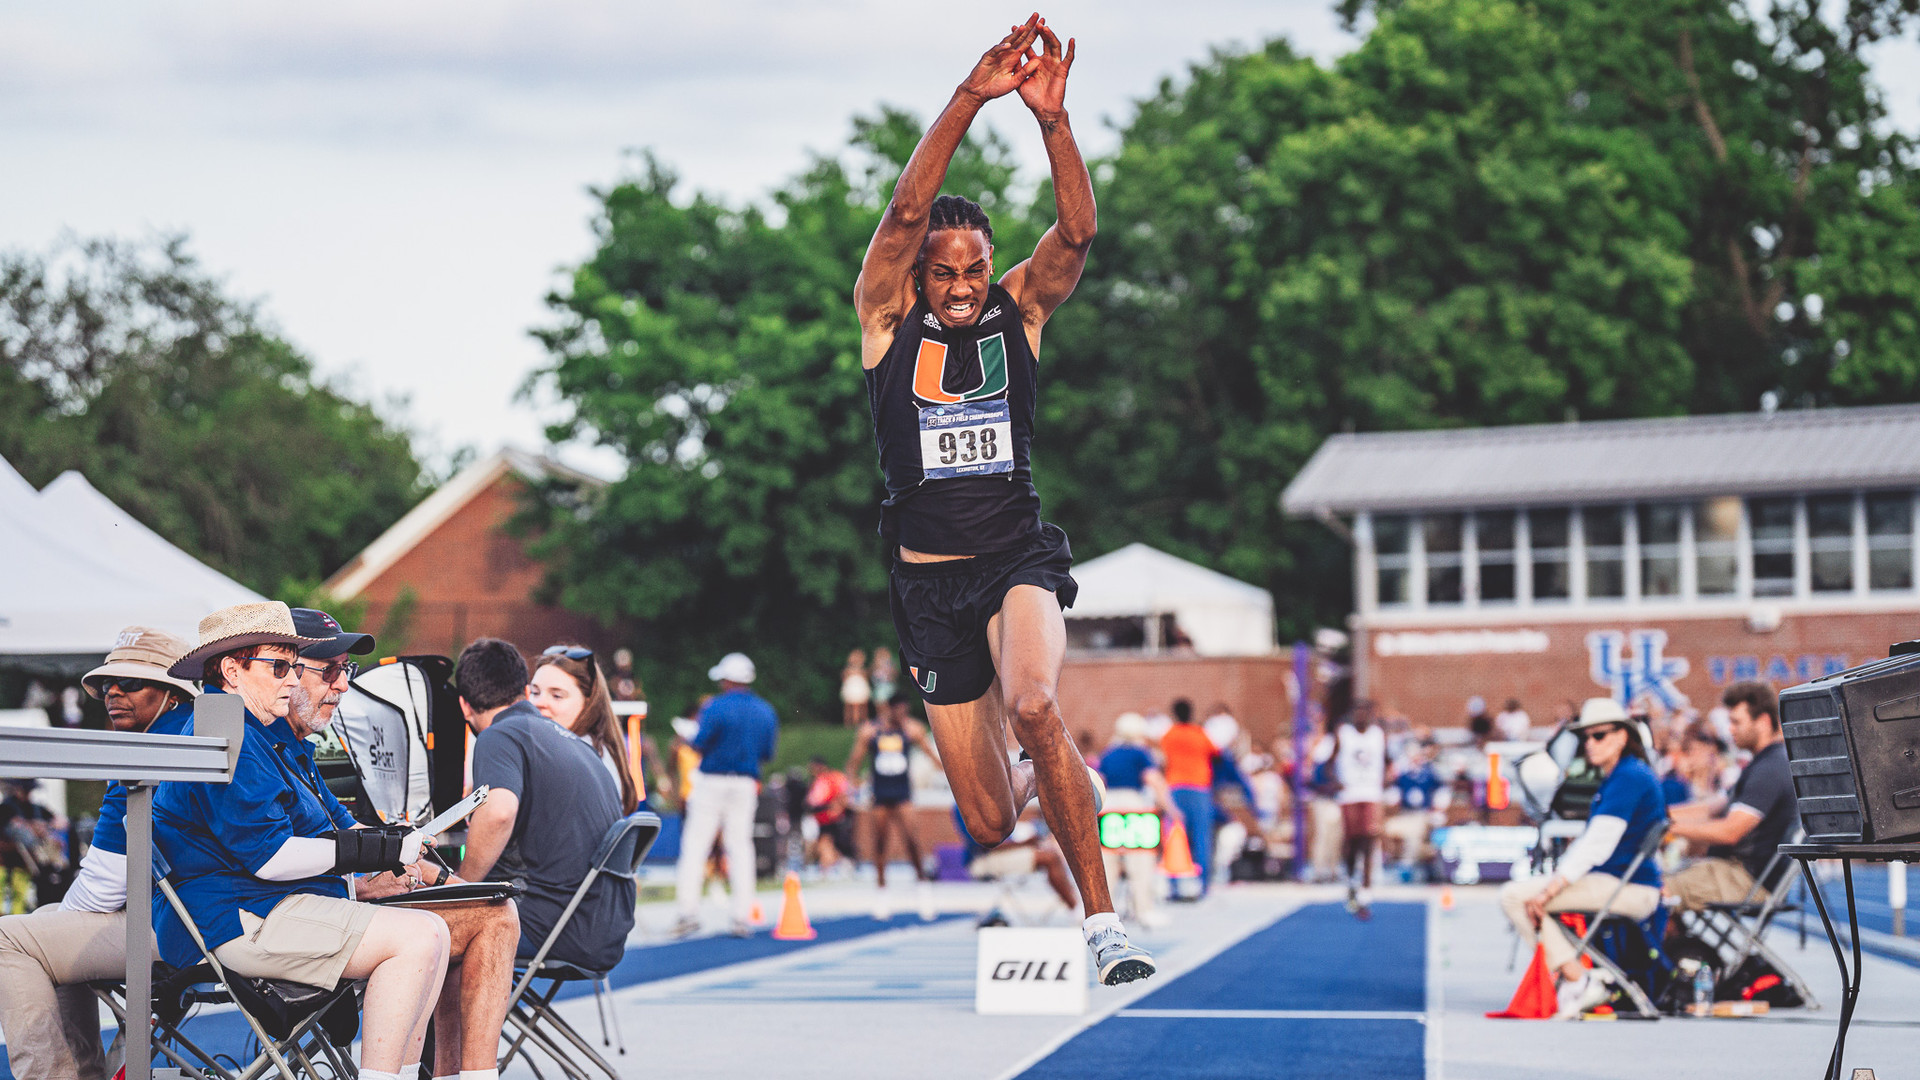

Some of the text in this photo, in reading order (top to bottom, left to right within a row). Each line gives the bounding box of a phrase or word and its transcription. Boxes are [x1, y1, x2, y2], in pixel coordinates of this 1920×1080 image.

[979, 304, 1002, 326] ACC
[912, 331, 1009, 405] U
[956, 414, 968, 422] FIELD
[938, 427, 998, 465] 938
[991, 960, 1071, 982] GILL
